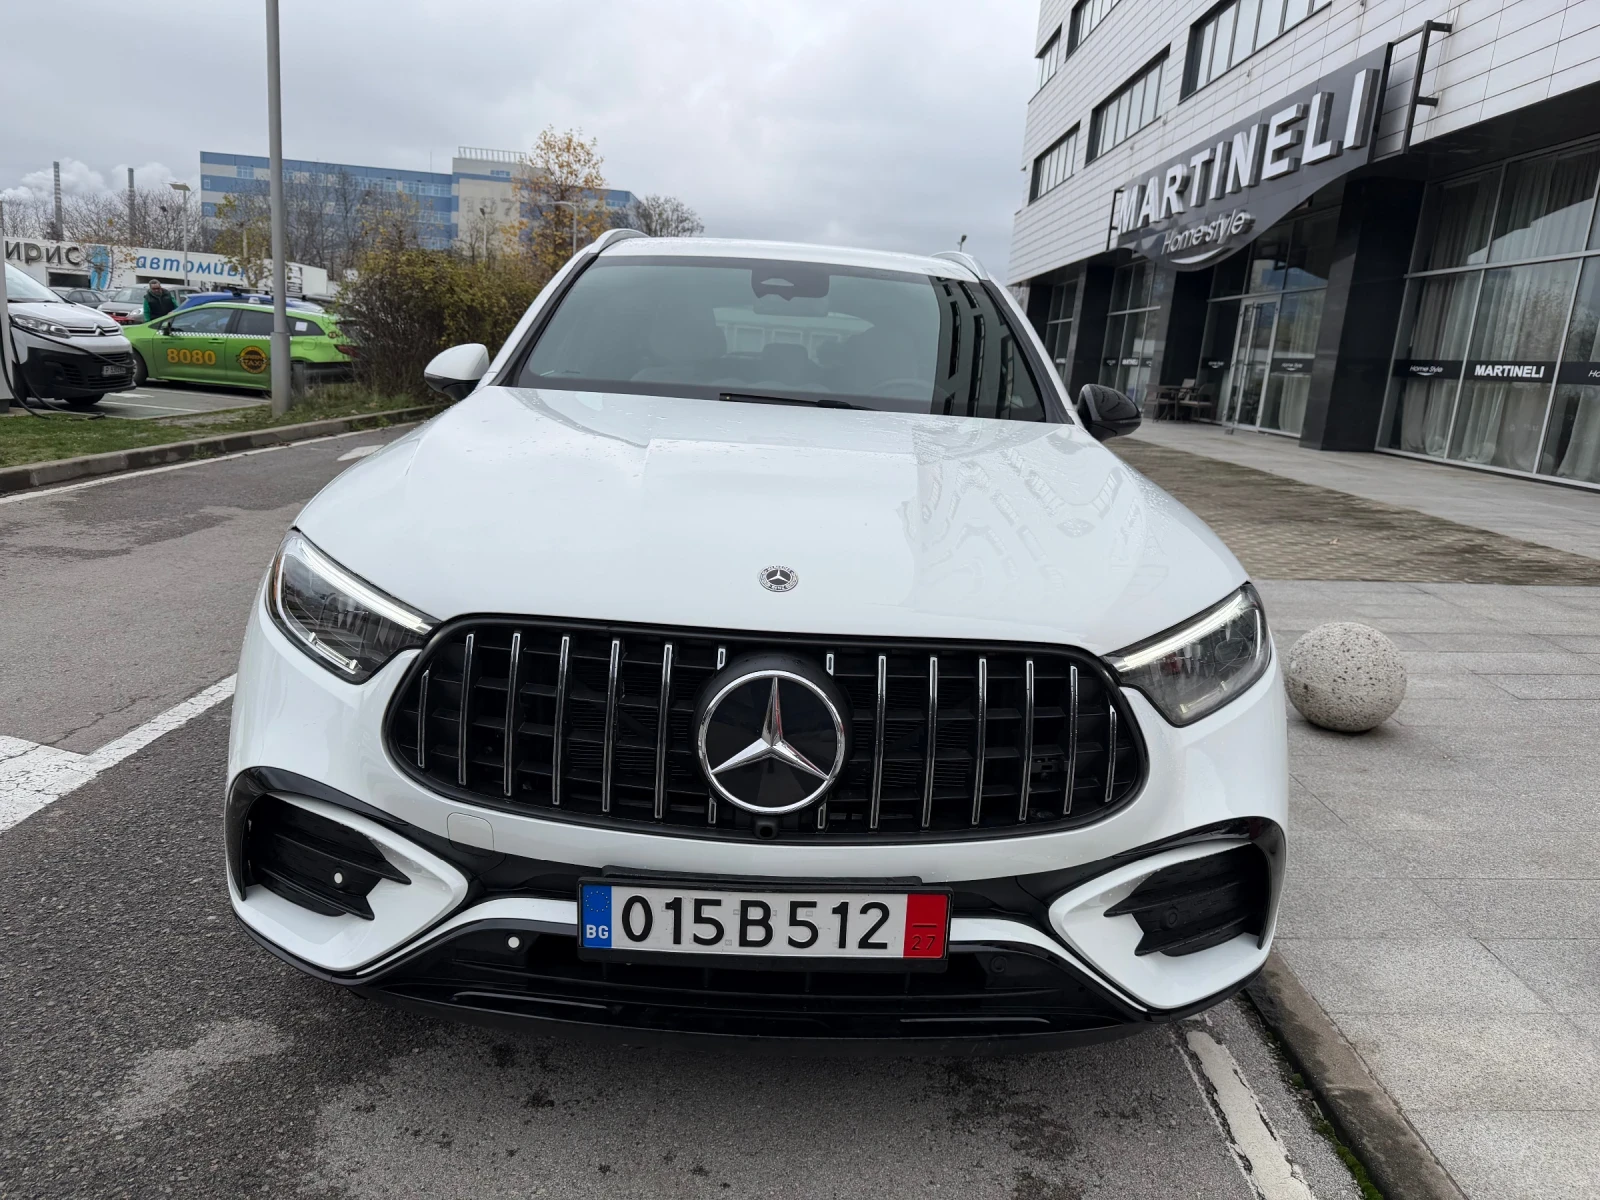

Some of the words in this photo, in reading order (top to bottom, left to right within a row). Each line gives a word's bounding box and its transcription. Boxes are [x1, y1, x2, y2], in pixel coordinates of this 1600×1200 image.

[1117, 68, 1379, 235] MARTINELI
[1161, 225, 1204, 255] Home
[135, 254, 246, 279] автомив
[166, 347, 217, 366] 8080
[1474, 364, 1545, 378] MARTINELI
[585, 924, 609, 940] BG
[911, 934, 936, 951] 27
